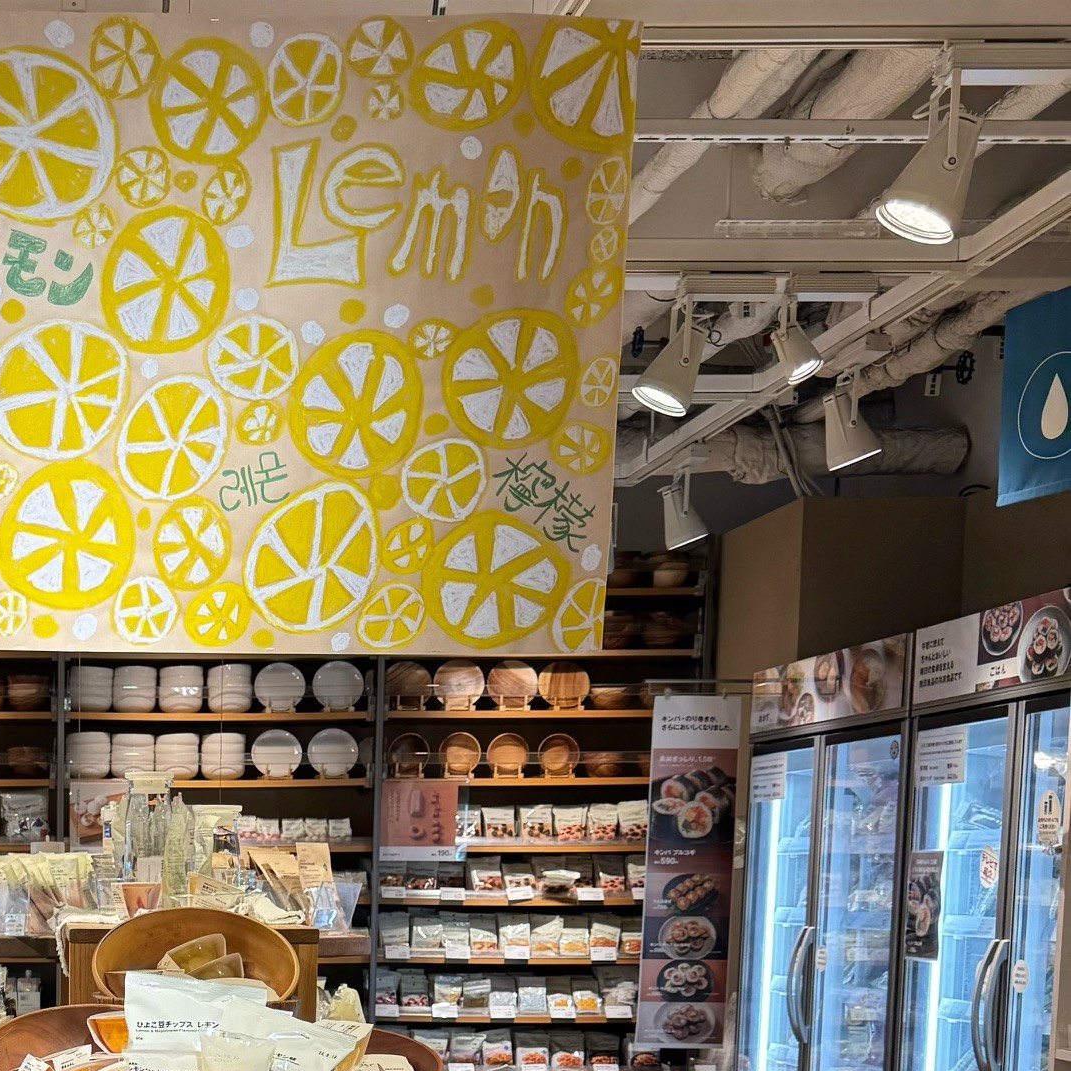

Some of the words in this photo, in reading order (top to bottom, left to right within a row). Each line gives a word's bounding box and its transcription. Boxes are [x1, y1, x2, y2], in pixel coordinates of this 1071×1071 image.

[266, 138, 568, 289] Lemon
[219, 451, 290, 513] 레몬
[990, 664, 1006, 676] ごはん
[661, 724, 733, 732] さらにおいしくなりました。
[136, 1021, 193, 1029] ひよこ豆チップス
